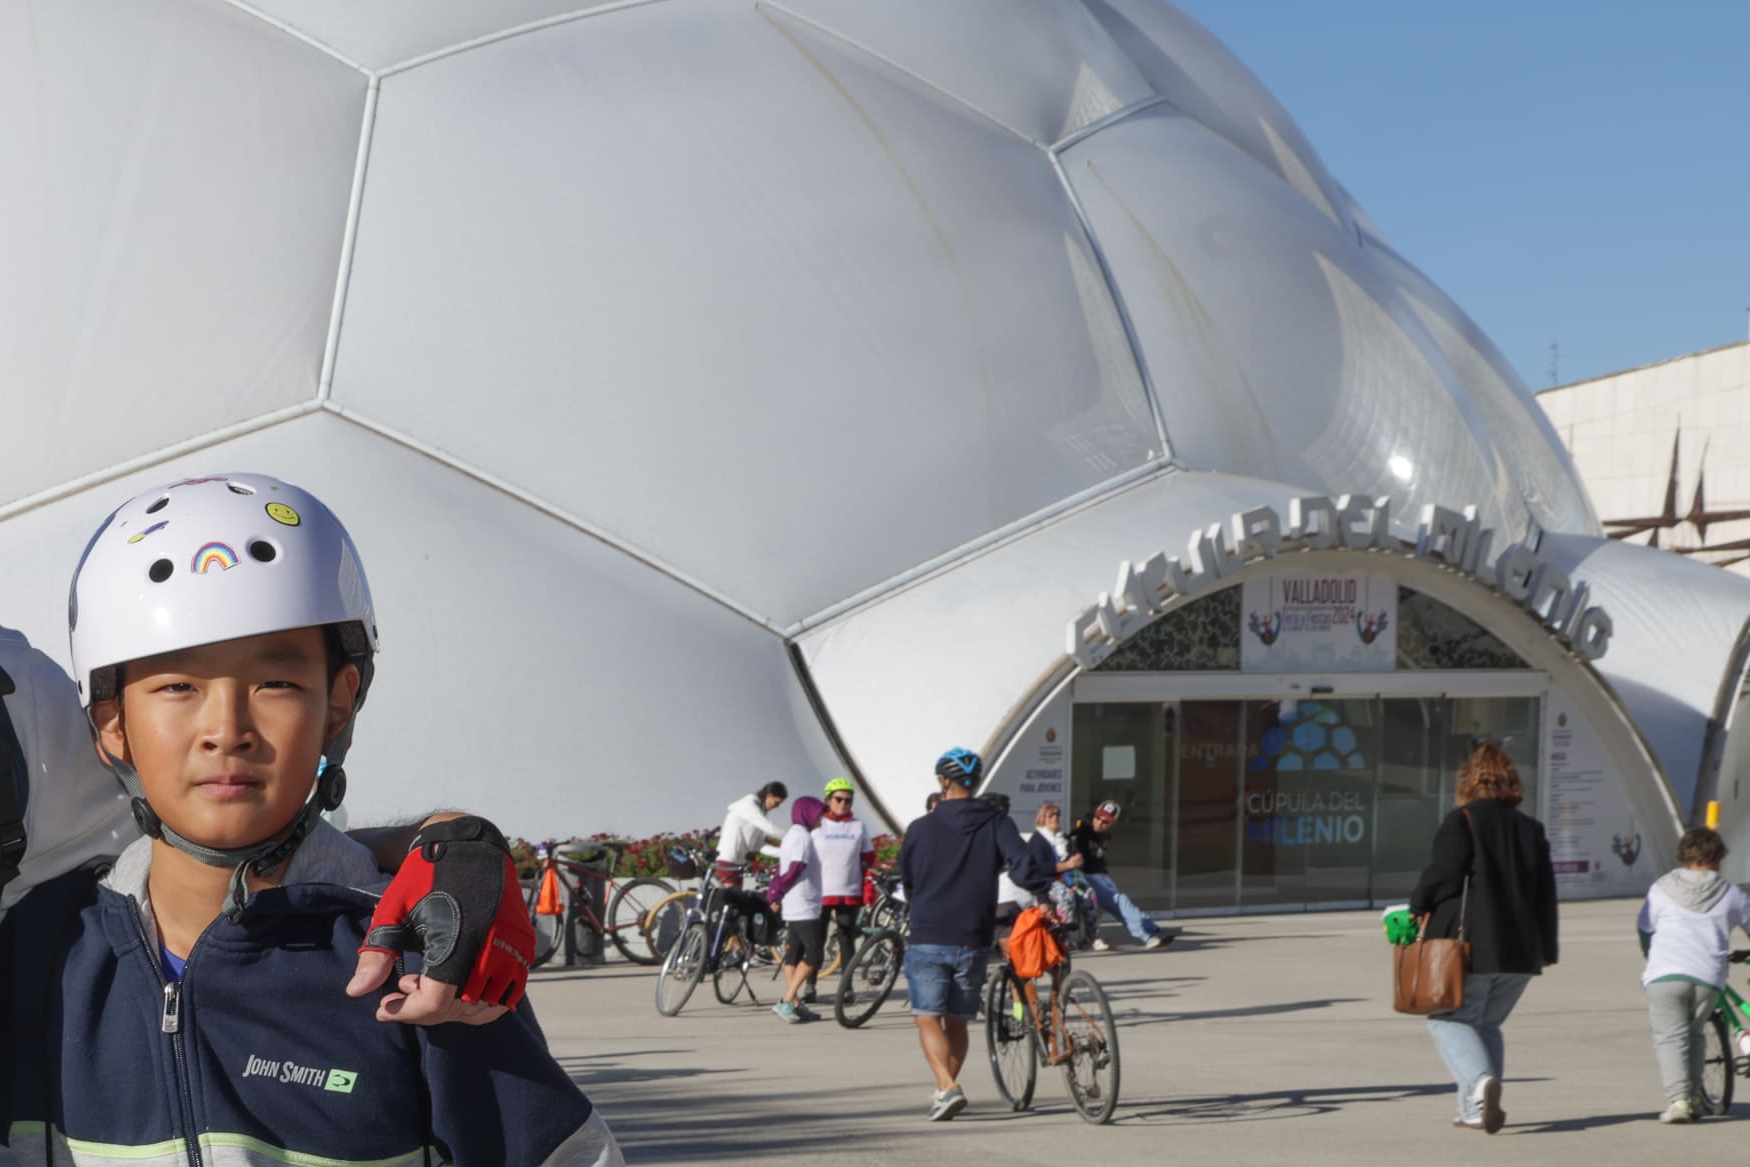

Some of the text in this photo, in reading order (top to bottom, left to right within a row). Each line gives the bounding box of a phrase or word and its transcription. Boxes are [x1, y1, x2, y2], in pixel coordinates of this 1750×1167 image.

[1282, 579, 1356, 605] VALLADOLID
[1331, 605, 1356, 625] 2024
[1248, 789, 1365, 814] CÚPULA DEL
[1247, 815, 1364, 846] MILENIO
[242, 1054, 326, 1087] JOHN SMITH
